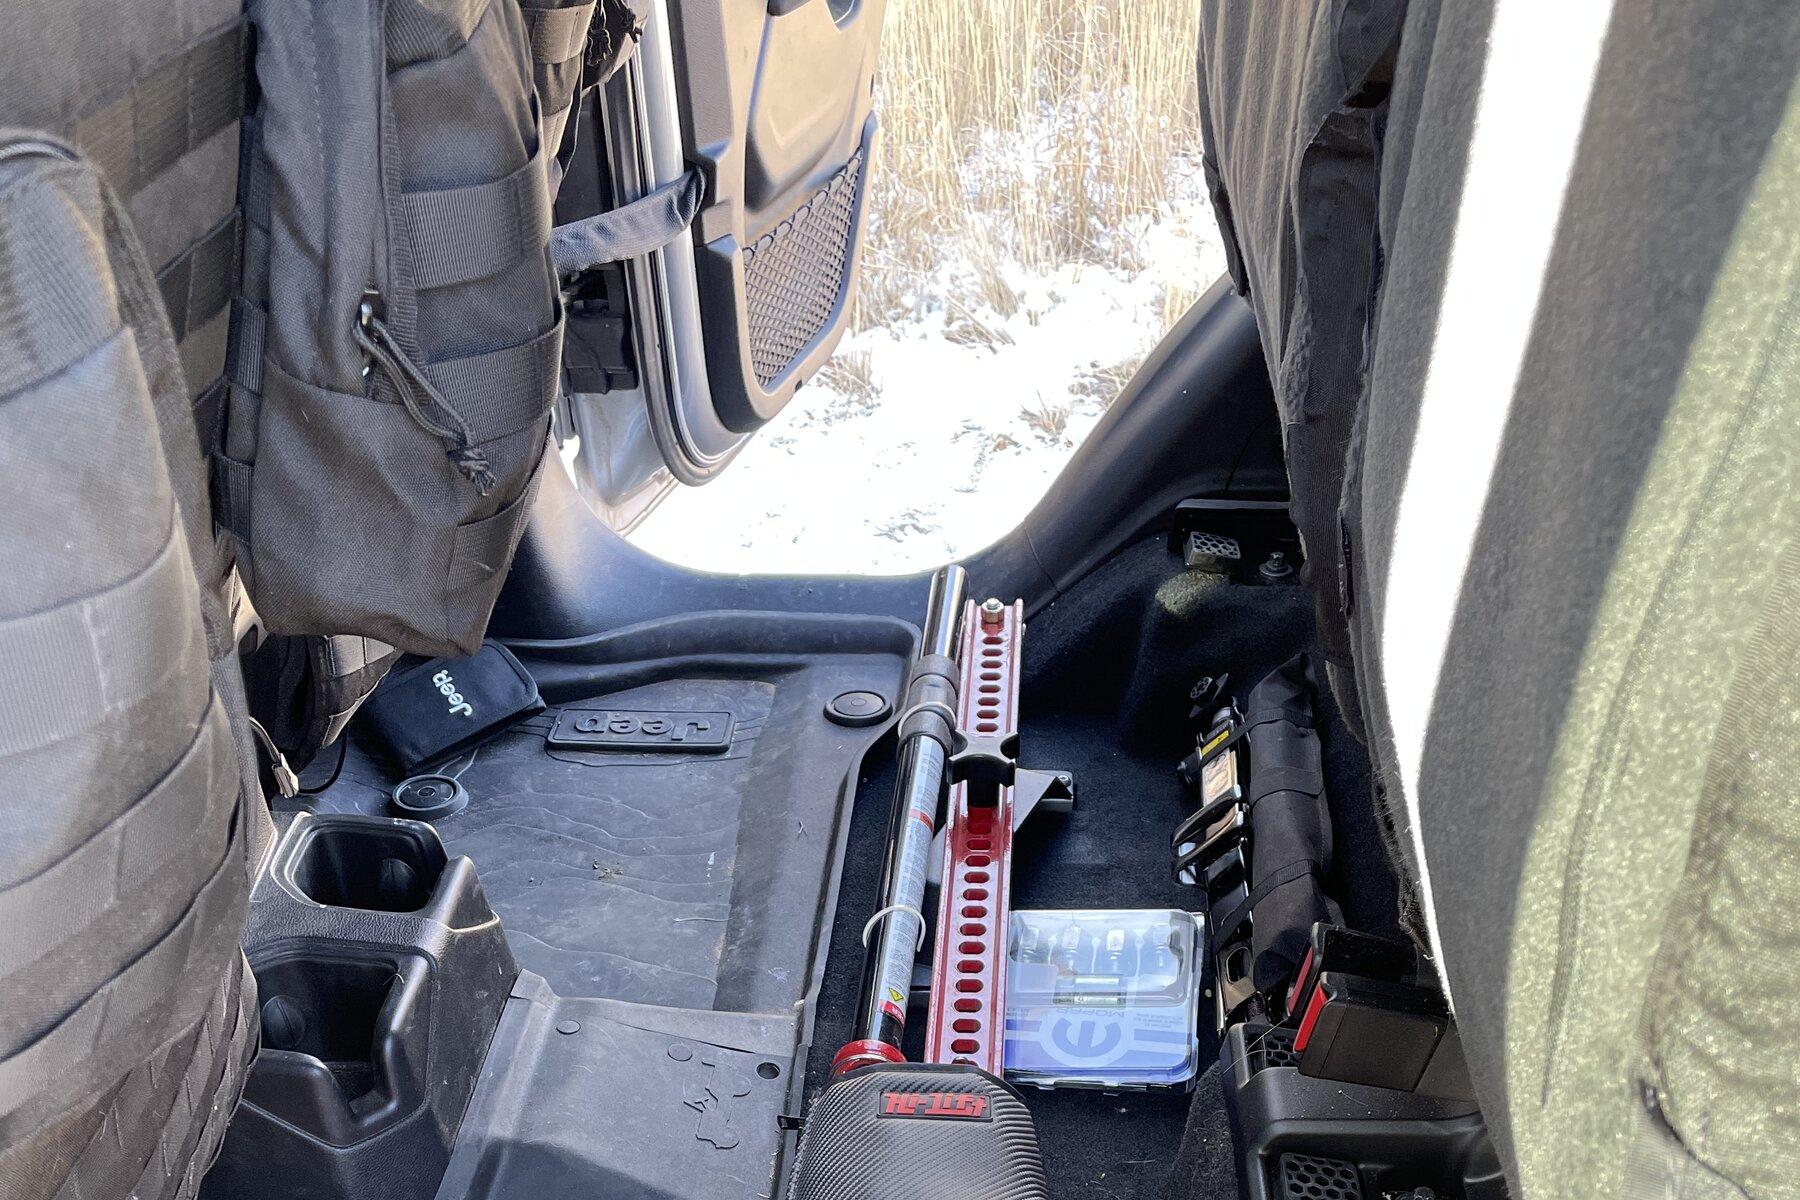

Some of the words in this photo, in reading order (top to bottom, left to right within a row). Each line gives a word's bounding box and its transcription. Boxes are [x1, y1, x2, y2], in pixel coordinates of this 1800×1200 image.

[432, 669, 473, 717] Jeep
[575, 712, 711, 742] Jeep
[1056, 1007, 1125, 1019] MOPAR
[884, 1091, 988, 1118] Hi-Lift
